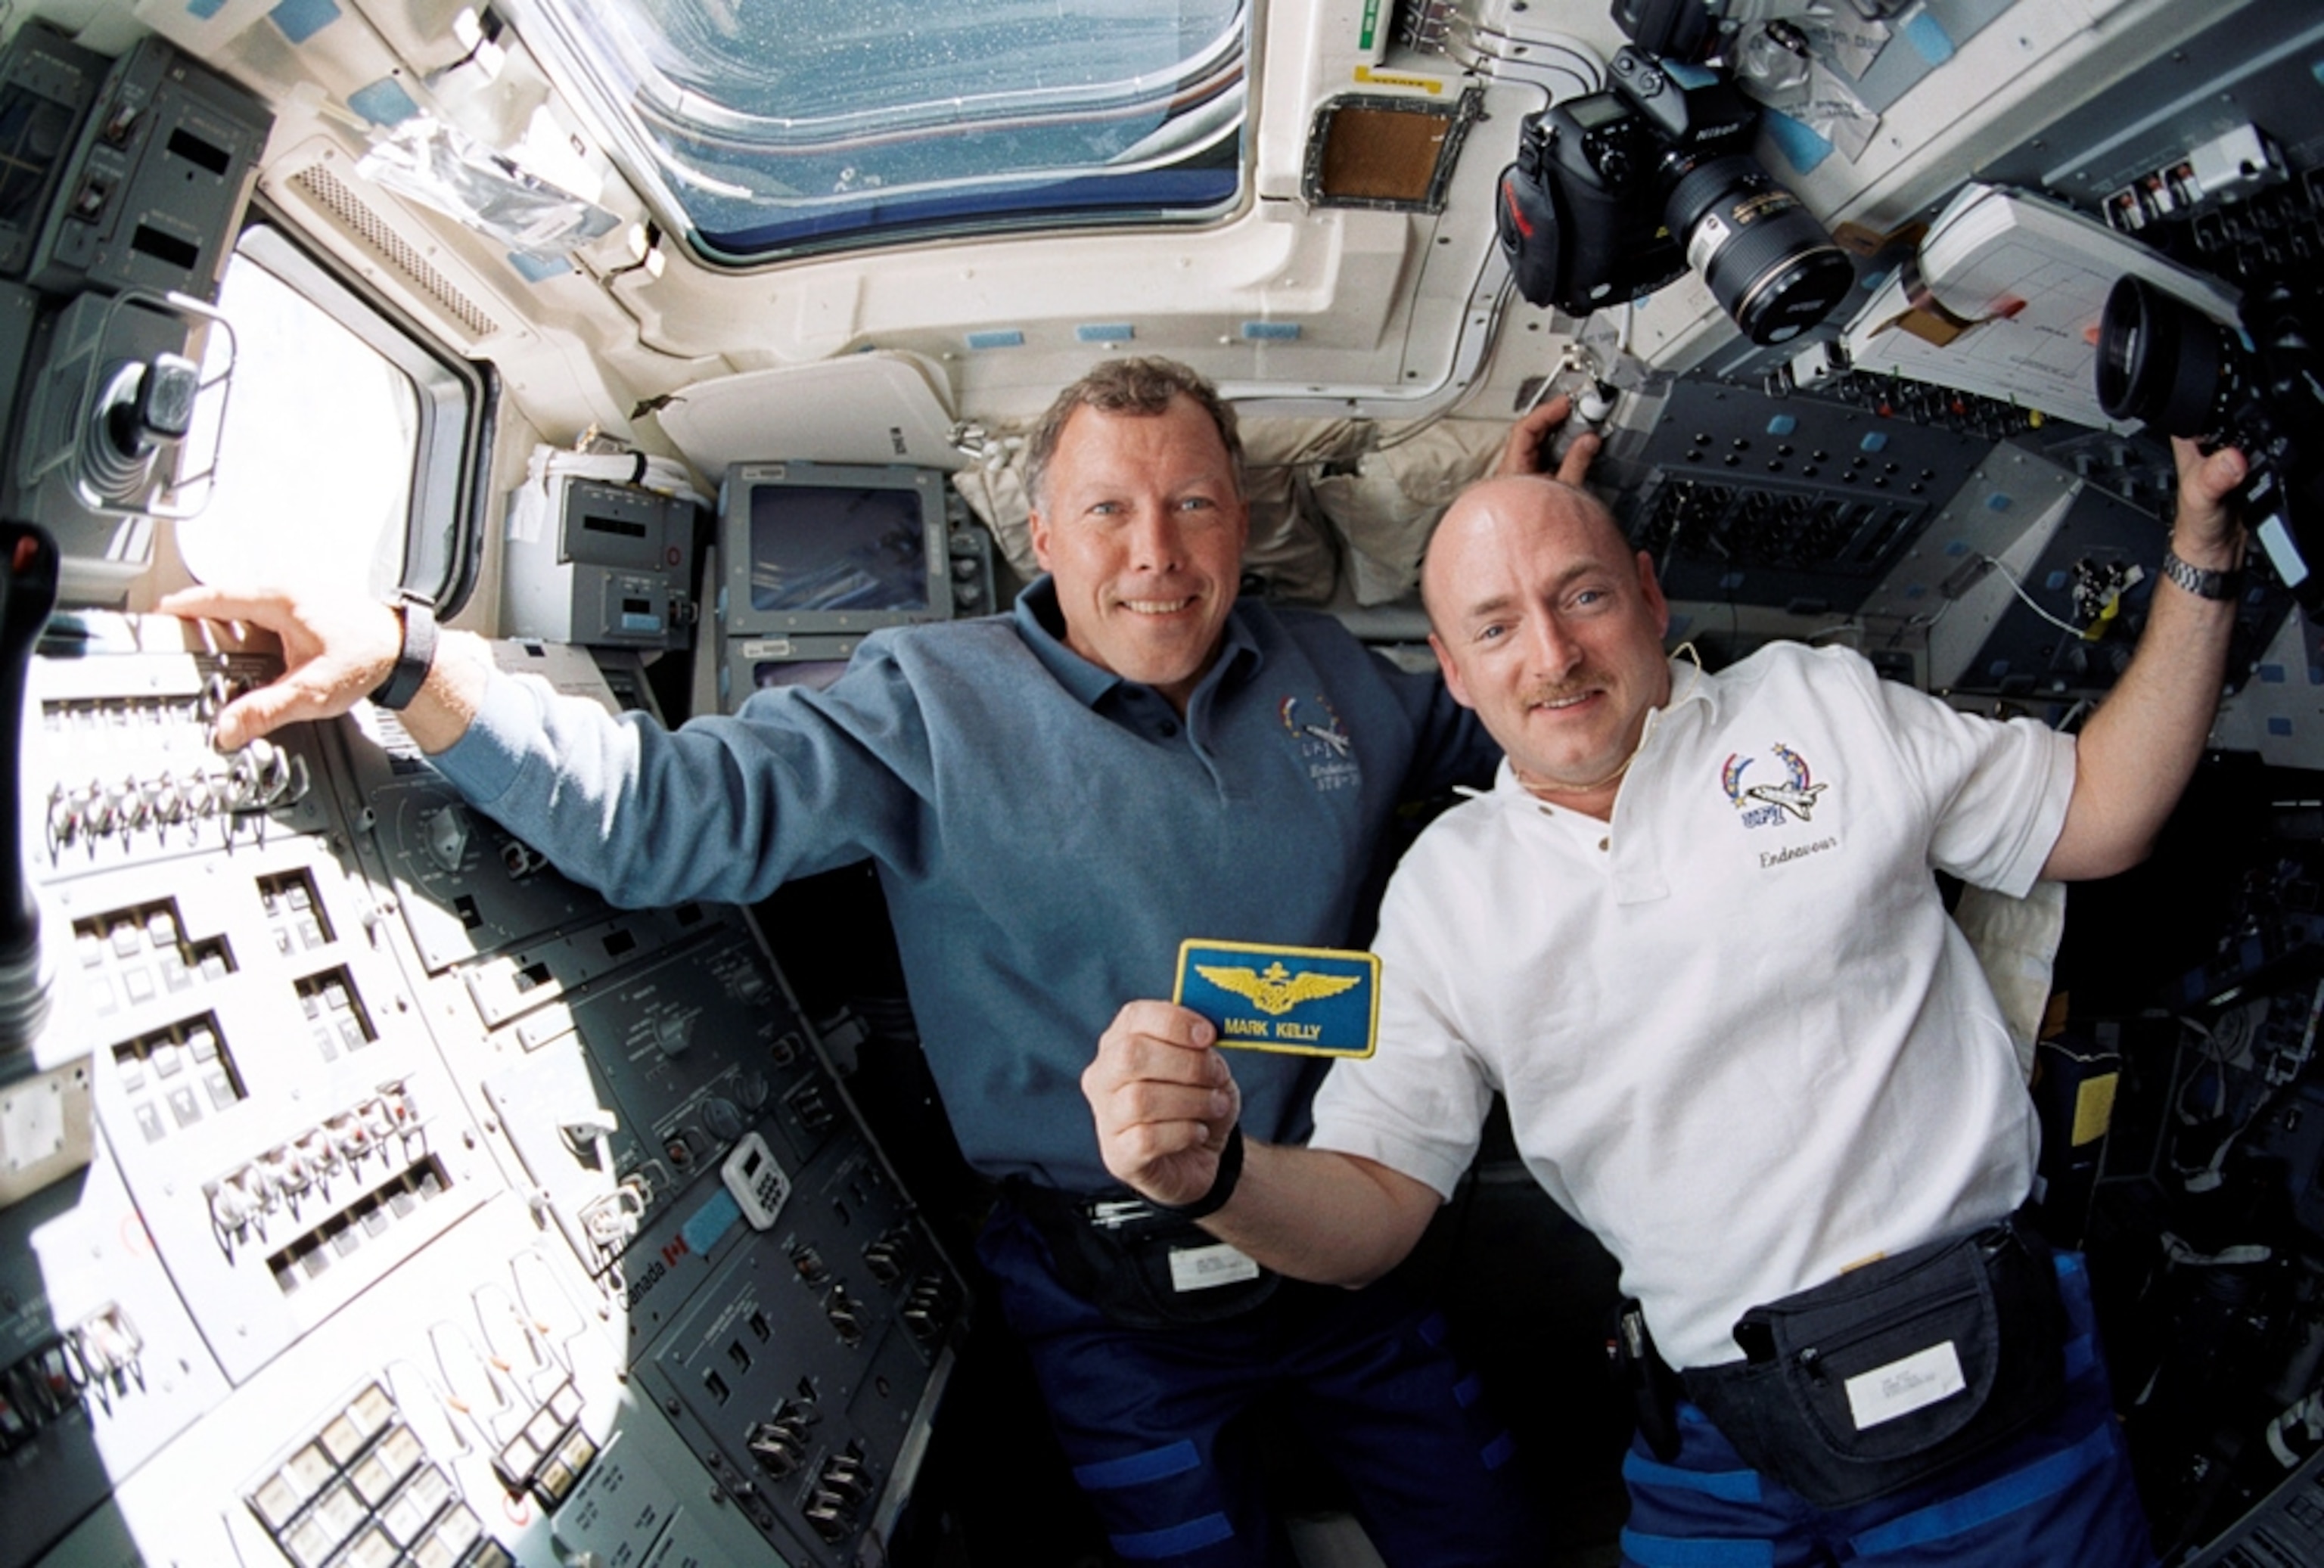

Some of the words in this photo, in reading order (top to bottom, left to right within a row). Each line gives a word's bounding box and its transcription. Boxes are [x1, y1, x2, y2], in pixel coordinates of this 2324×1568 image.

[1695, 122, 1740, 141] Nikon
[1759, 837, 1837, 868] Endeavour
[1224, 1018, 1269, 1036] MARK
[1276, 1022, 1322, 1041] KELLY
[617, 1261, 666, 1312] Canada
